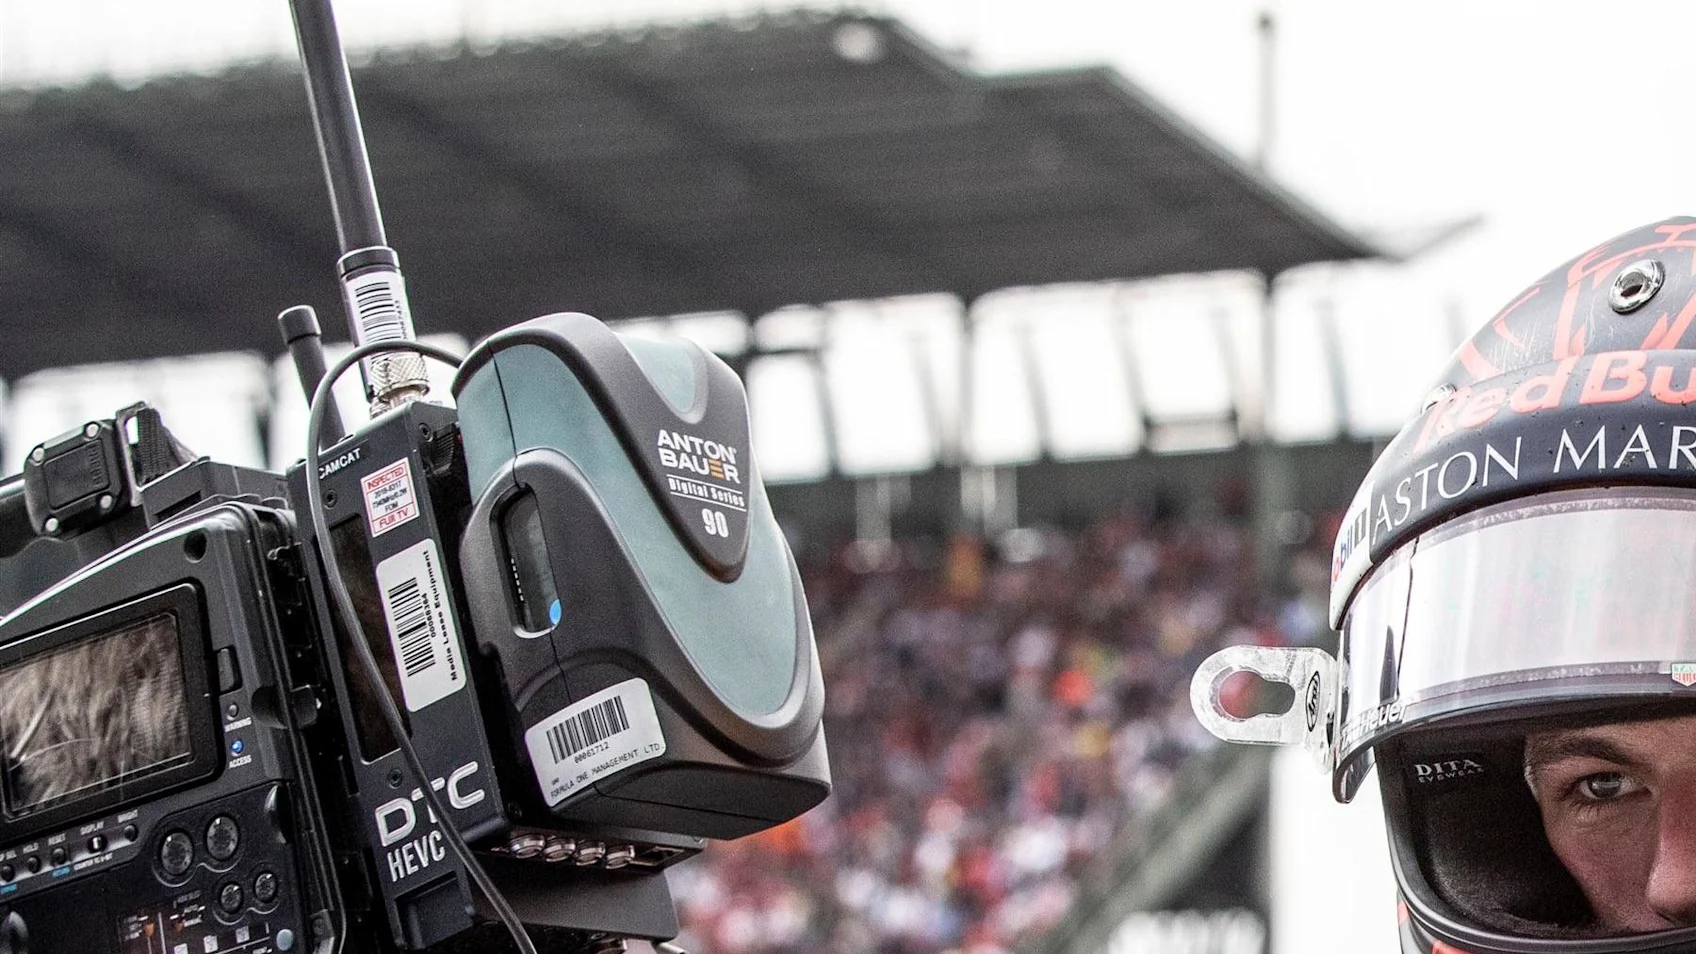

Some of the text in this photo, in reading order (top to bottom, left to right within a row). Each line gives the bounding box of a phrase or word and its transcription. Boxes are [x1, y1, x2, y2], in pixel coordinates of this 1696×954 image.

[658, 429, 736, 464] ANTON
[658, 447, 740, 484] BAUER
[668, 478, 745, 507] Digital Series
[1372, 436, 1522, 546] ASTON
[702, 508, 728, 538] 90
[1333, 525, 1353, 582] obil
[422, 551, 441, 609] Equipment
[447, 648, 458, 681] Media
[229, 754, 252, 769] ACCESS
[550, 780, 575, 799] FORMULA
[576, 771, 589, 784] ONE
[592, 748, 639, 775] MANAGEMENT
[1414, 759, 1482, 776] DITA
[375, 761, 485, 847] DTC
[387, 830, 446, 882] HEVC
